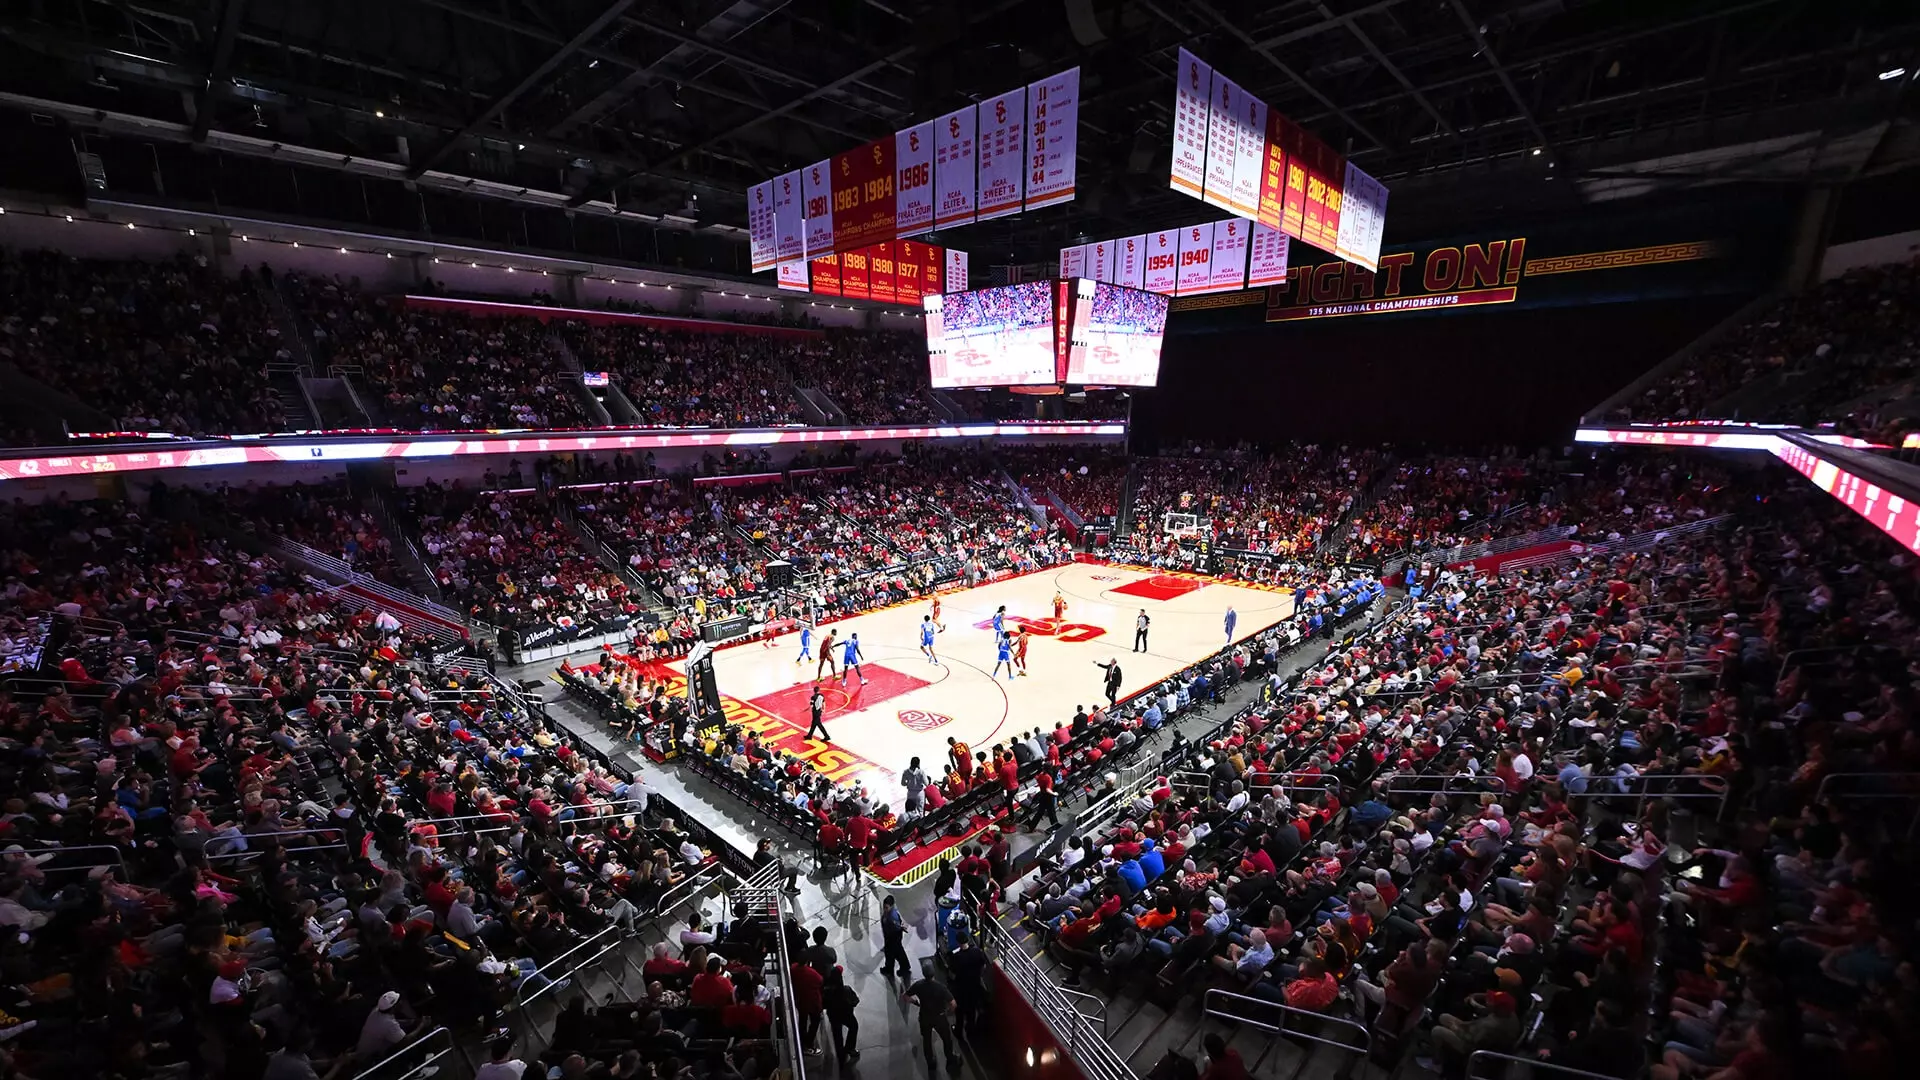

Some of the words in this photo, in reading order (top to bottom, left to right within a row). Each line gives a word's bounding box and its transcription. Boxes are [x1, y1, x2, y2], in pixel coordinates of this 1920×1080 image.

[1039, 86, 1047, 101] 11
[1036, 103, 1046, 120] 14
[1034, 120, 1045, 136] 30
[1036, 136, 1045, 152] 31
[1033, 154, 1045, 169] 33
[900, 162, 929, 191] 1986
[1032, 170, 1044, 185] 44
[1288, 163, 1305, 193] 1981
[864, 174, 893, 203] 1984
[984, 187, 1005, 199] SWEET
[1007, 184, 1016, 194] 16
[1307, 176, 1326, 204] 2002
[808, 195, 828, 219] 1981
[834, 186, 859, 212] 1983
[944, 198, 960, 210] ELITE
[1325, 186, 1342, 213] 2003
[898, 209, 914, 219] FINAL
[915, 205, 931, 216] FOUR
[844, 252, 866, 270] 1988
[872, 257, 893, 274] 1980
[1148, 254, 1174, 271] 1954
[1181, 248, 1209, 266] 1940
[1423, 238, 1526, 292] ON!
[898, 262, 919, 278] 1977
[813, 275, 840, 285] CHAMPIONS
[843, 280, 868, 289] CHAMPIONS
[1309, 308, 1323, 316] 135
[1325, 303, 1372, 315] NATIONAL
[1374, 295, 1459, 311] CHAMPIONSHIPS
[1059, 306, 1067, 355] USC
[956, 745, 966, 755] 24
